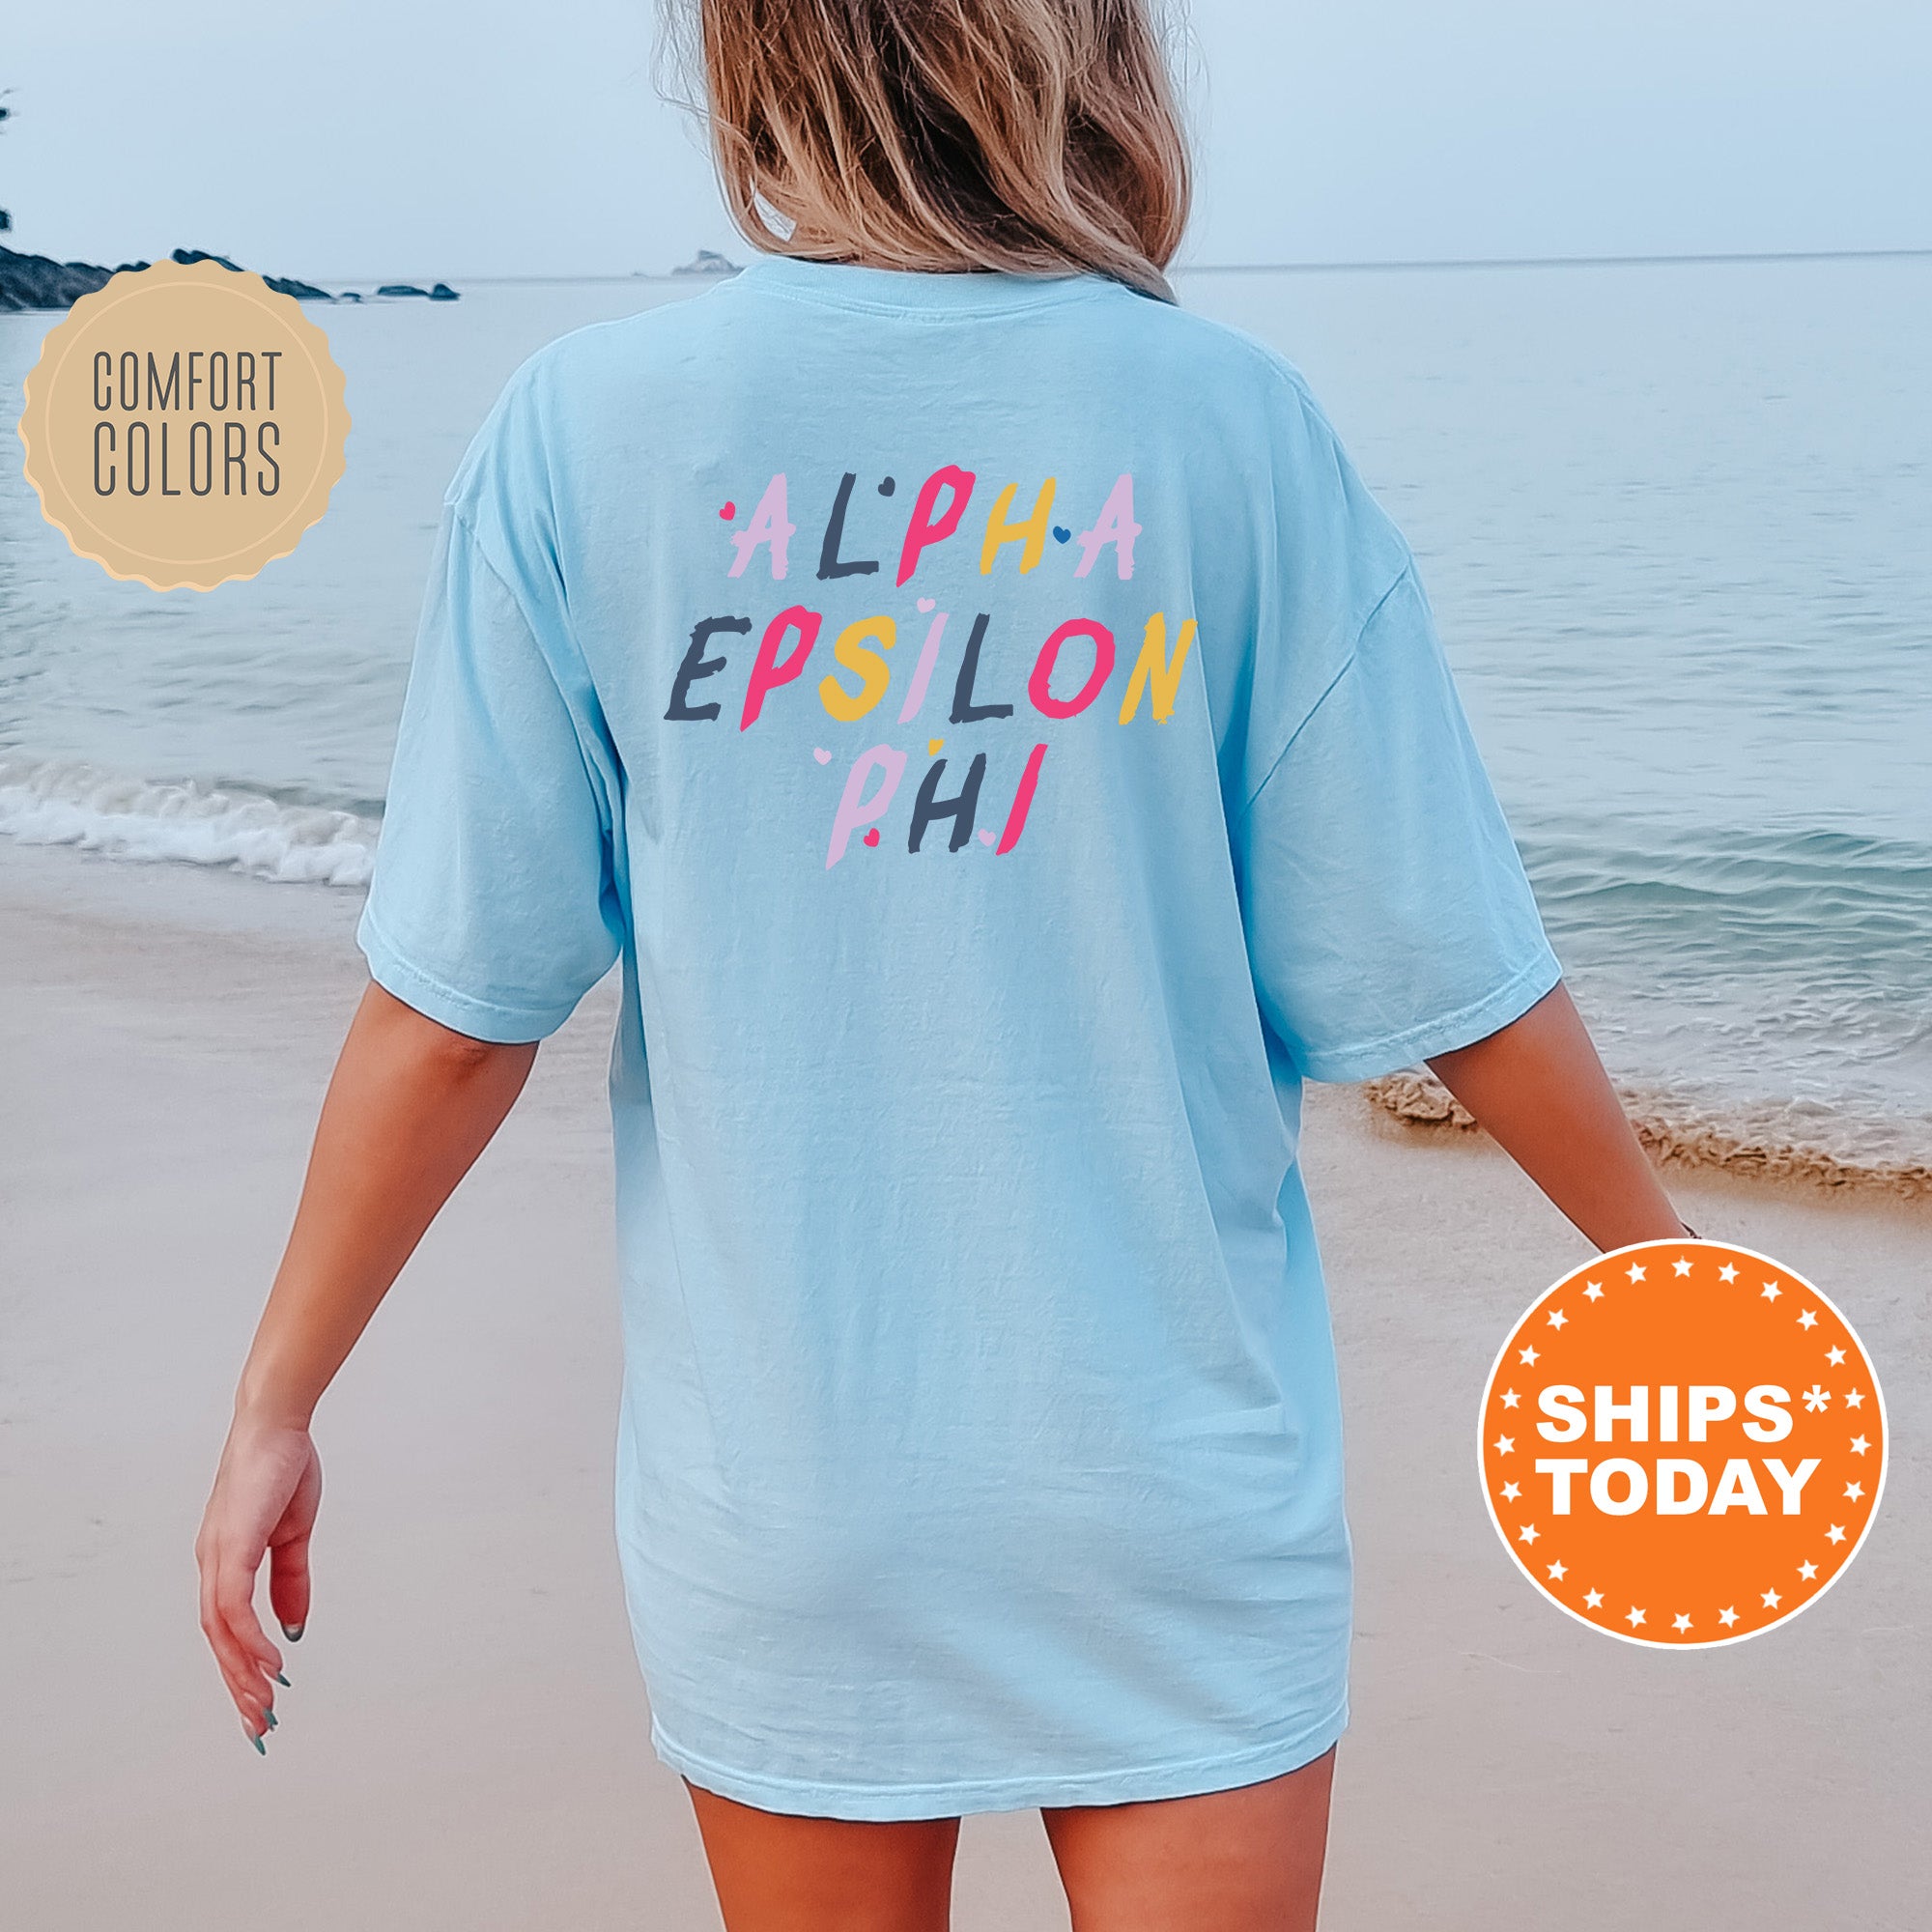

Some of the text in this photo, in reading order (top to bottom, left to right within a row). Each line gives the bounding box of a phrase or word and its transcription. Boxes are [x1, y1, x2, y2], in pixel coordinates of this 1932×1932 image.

[726, 464, 1144, 588] ALPHA
[663, 604, 1199, 732] EPSILON
[825, 743, 1049, 870] PHI
